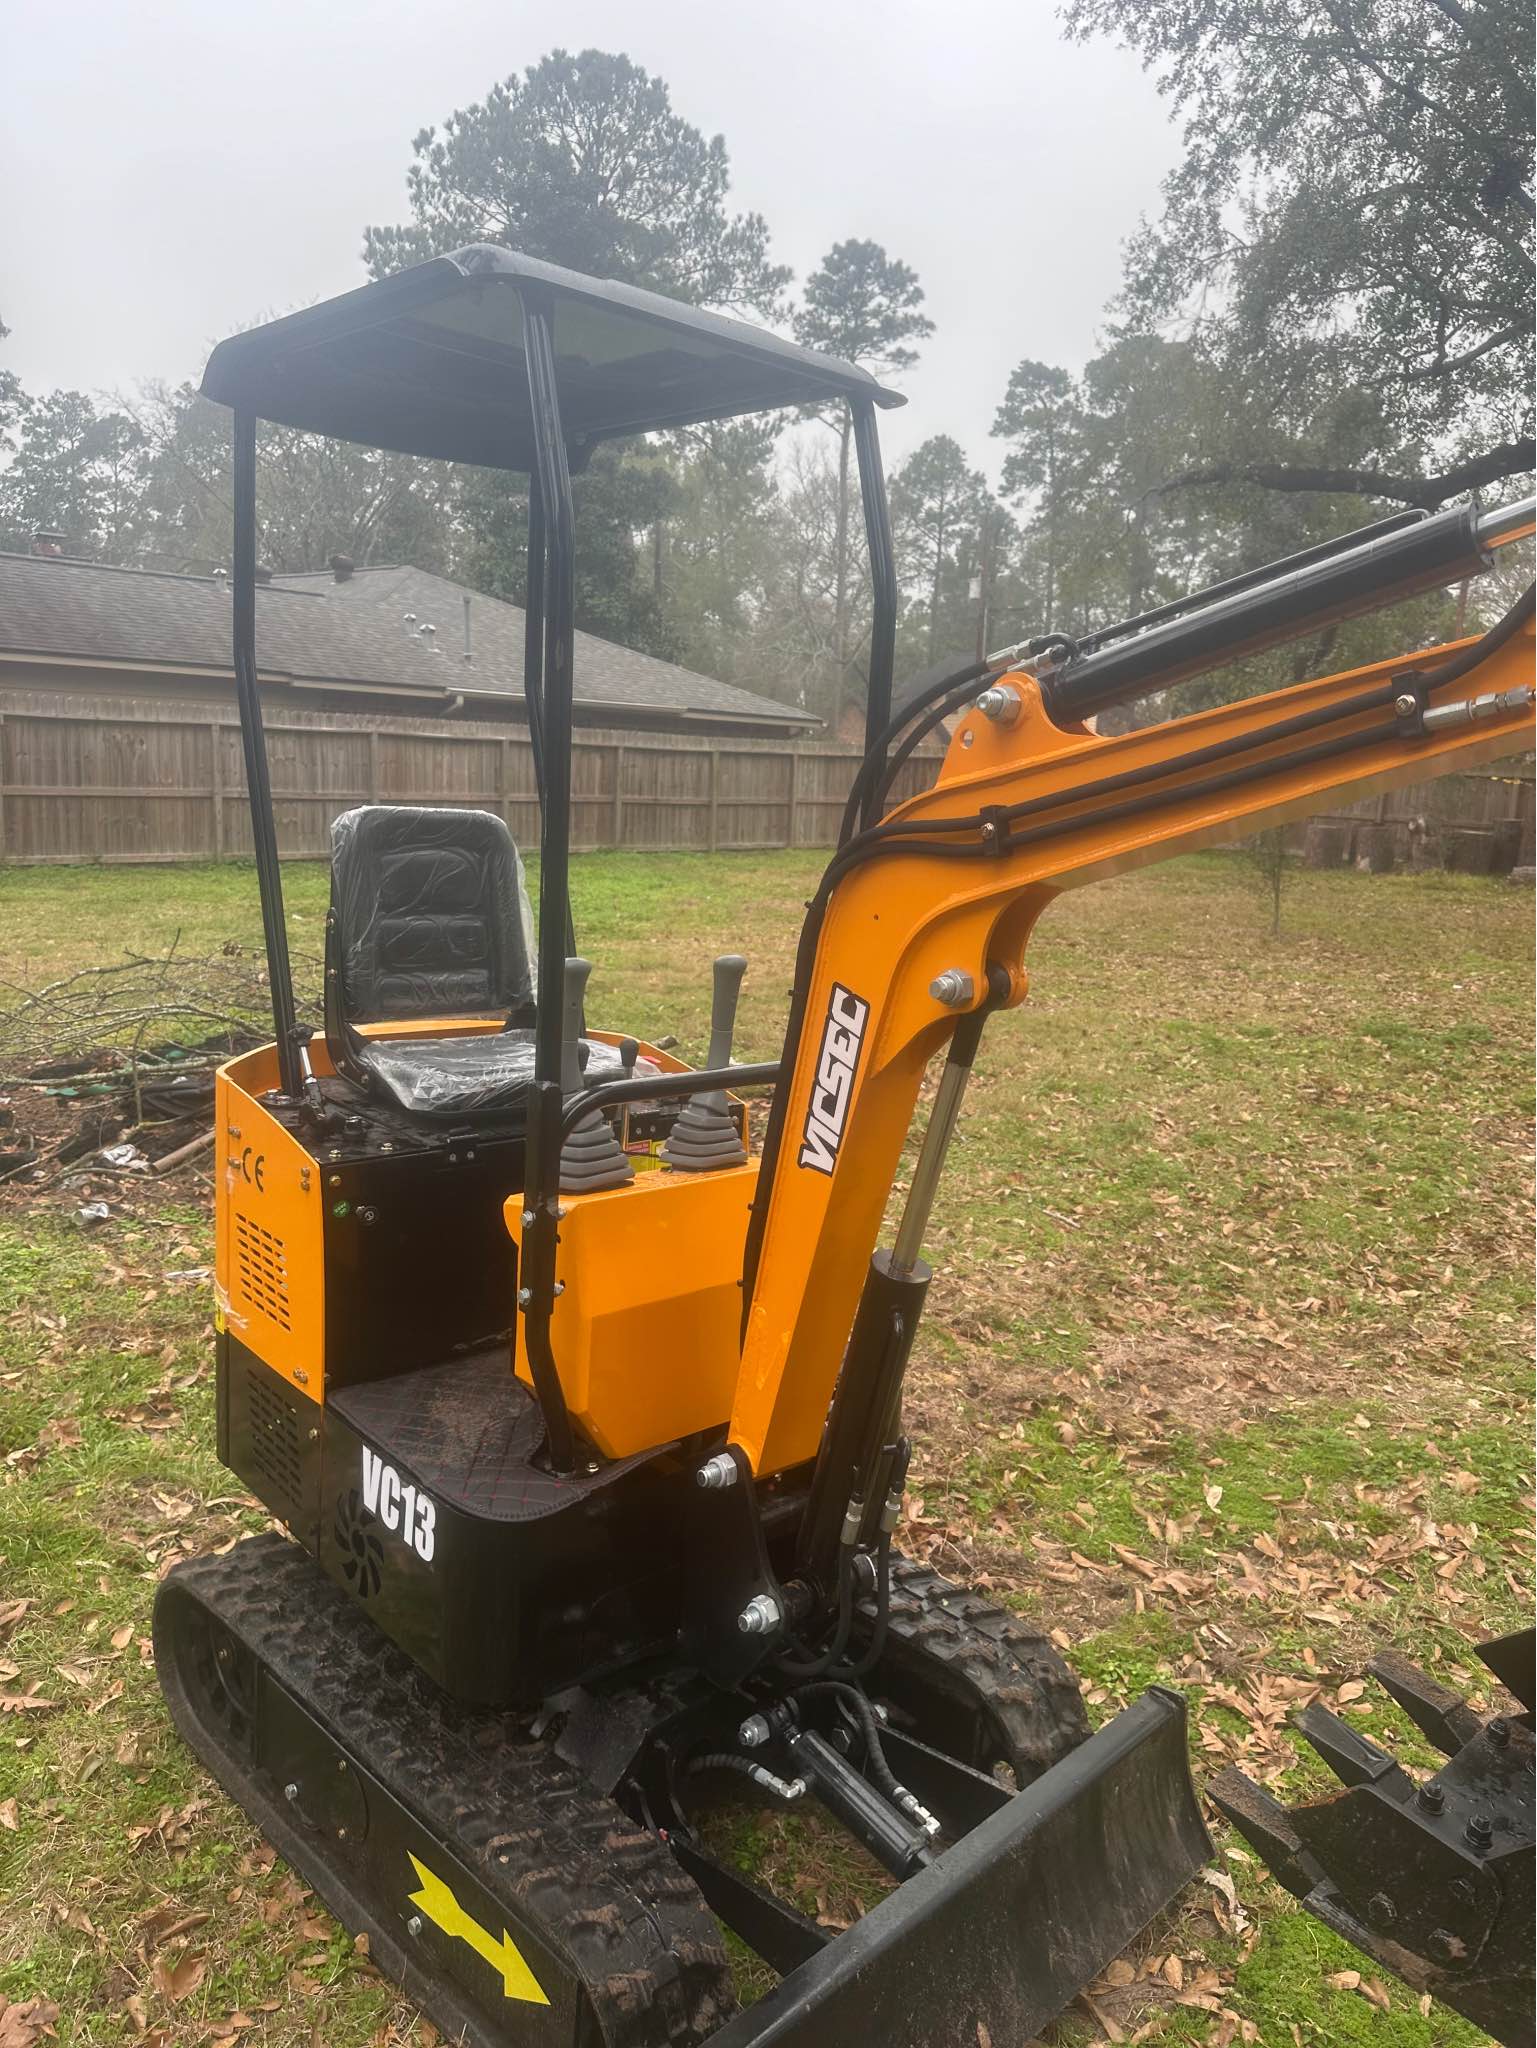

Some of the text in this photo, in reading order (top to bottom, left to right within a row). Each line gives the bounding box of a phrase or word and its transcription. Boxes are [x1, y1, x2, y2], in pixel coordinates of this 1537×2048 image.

[800, 985, 868, 1174] VICSEC
[242, 1147, 265, 1192] CE
[362, 1444, 436, 1562] VC13
